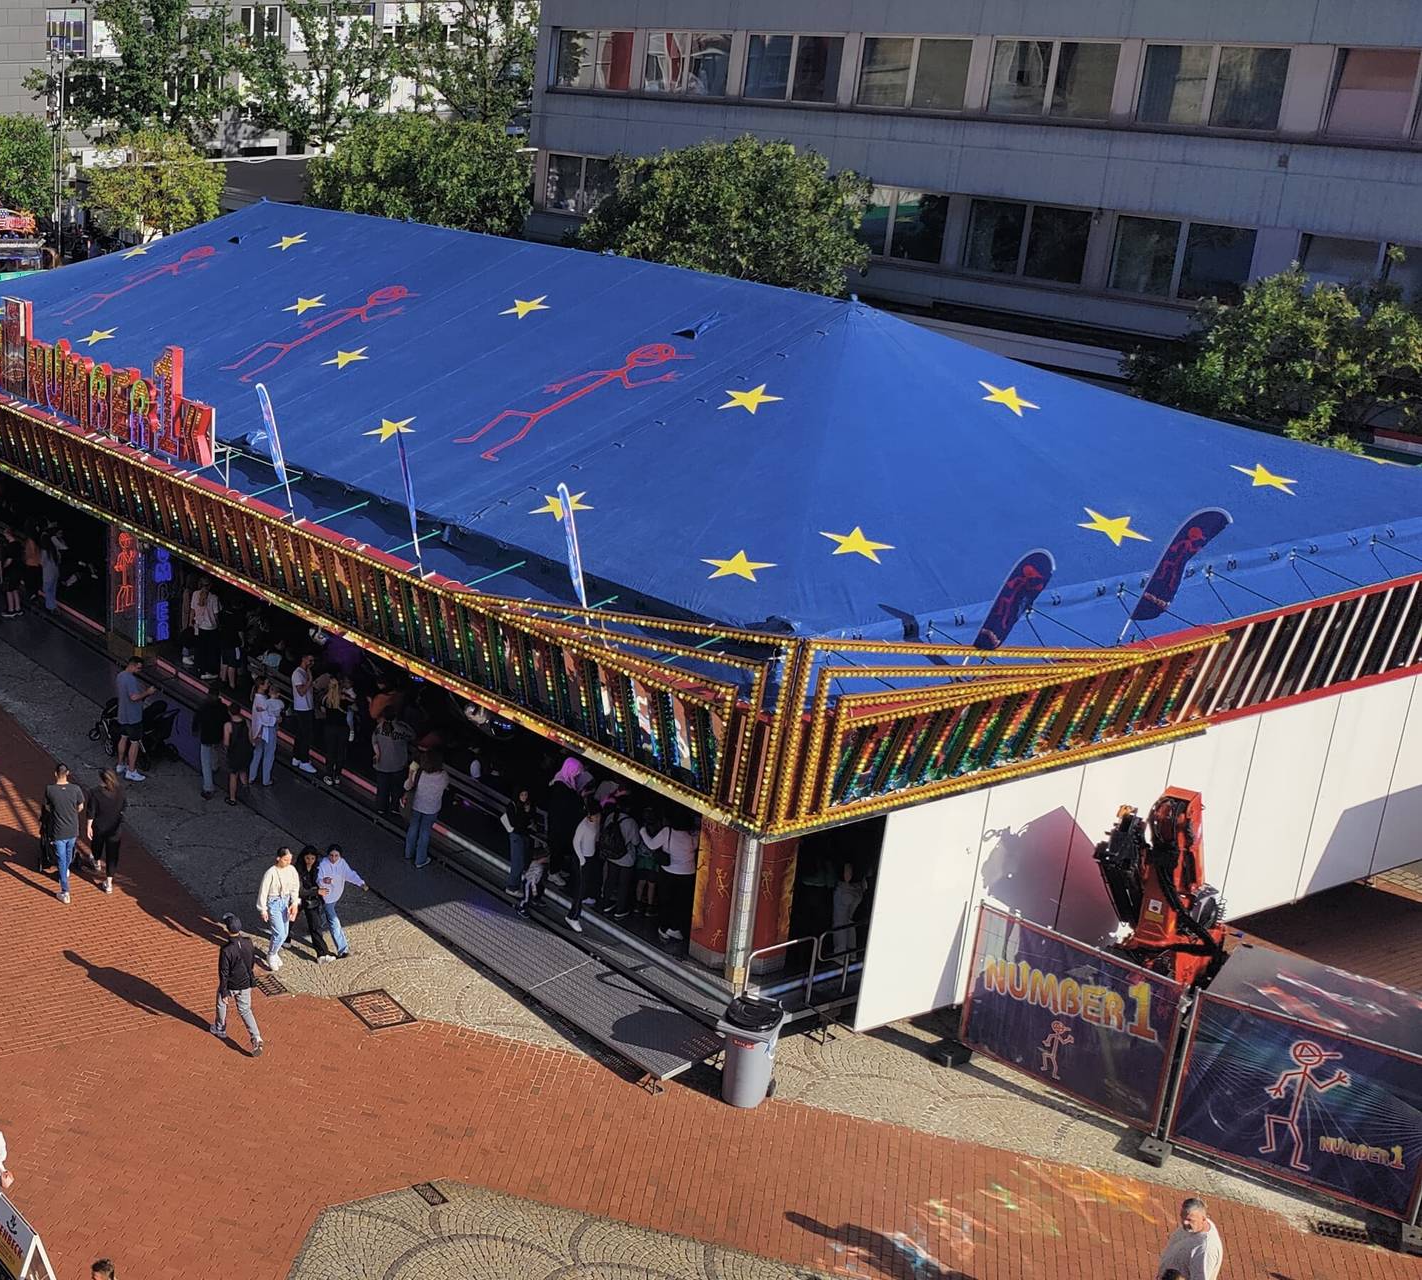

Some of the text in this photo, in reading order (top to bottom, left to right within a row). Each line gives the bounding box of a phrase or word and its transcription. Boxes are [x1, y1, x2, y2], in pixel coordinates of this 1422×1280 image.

[27, 338, 155, 450] NUMBER
[984, 954, 1158, 1043] NUMBER 1
[1319, 1136, 1406, 1170] NUMBER 1
